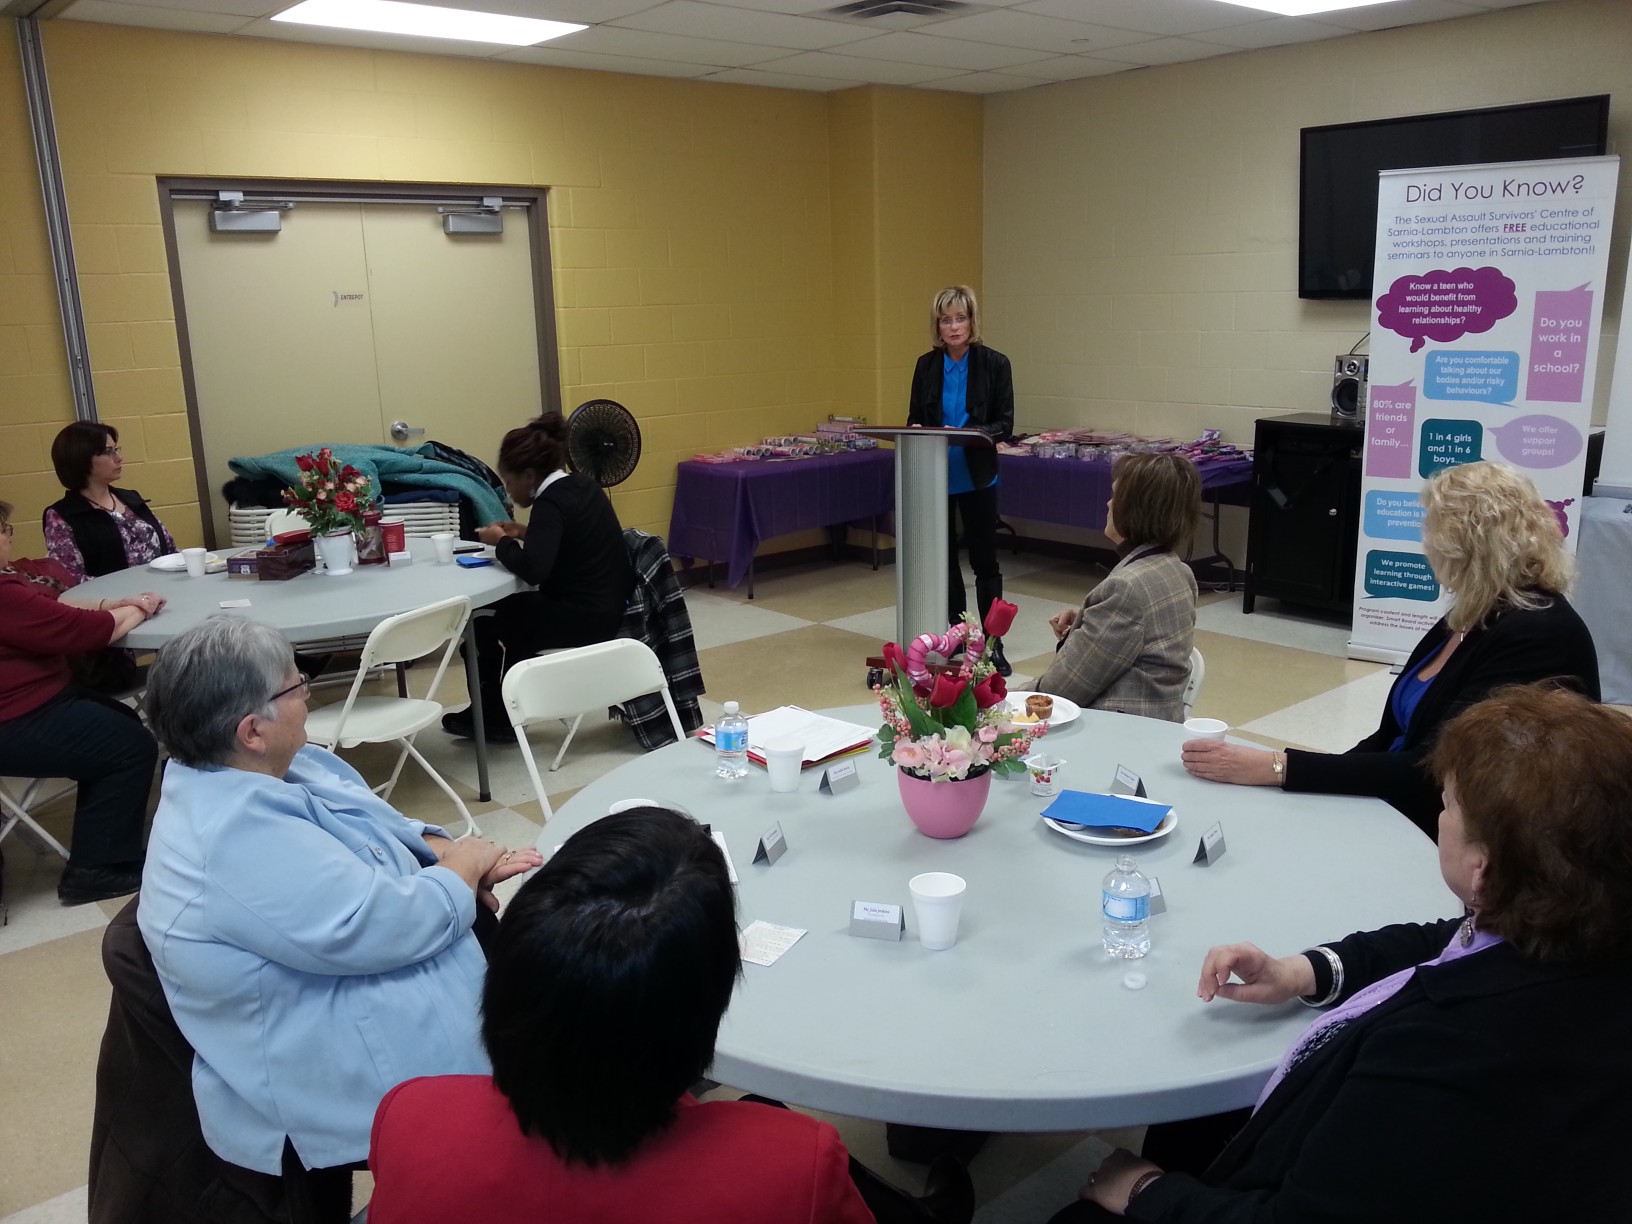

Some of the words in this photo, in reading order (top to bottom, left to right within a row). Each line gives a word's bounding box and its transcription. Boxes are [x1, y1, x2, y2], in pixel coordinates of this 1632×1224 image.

[1406, 183, 1443, 203] Did
[1451, 182, 1494, 200] You
[1502, 174, 1585, 198] Know?
[1394, 216, 1412, 225] The
[1414, 214, 1448, 224] Sexual
[1450, 212, 1486, 222] Assault
[1540, 209, 1579, 219] Centre
[1582, 206, 1595, 217] of
[1387, 225, 1468, 237] Sarnia-Lambton
[1470, 224, 1499, 234] offers
[1503, 223, 1527, 233] FREE
[1530, 220, 1600, 231] educational
[1392, 238, 1447, 248] workshops,
[1450, 236, 1521, 248] presentations
[1523, 234, 1547, 244] and
[1550, 233, 1592, 244] training
[1387, 251, 1430, 260] seminars
[1433, 250, 1443, 259] to
[1446, 249, 1486, 259] anyone
[1489, 248, 1498, 257] in
[1501, 245, 1595, 257] Sarnia-Lambton!!
[1409, 282, 1431, 290] Know
[1440, 282, 1456, 290] teen
[1457, 282, 1474, 290] who
[1406, 293, 1429, 302] would
[1430, 293, 1456, 301] benefit
[1458, 293, 1476, 301] from
[1398, 305, 1429, 314] learning
[1430, 304, 1453, 313] about
[1453, 304, 1482, 314] healthy
[1412, 316, 1466, 325] relationships?
[1540, 317, 1557, 327] Do
[1560, 319, 1583, 329] you
[1538, 332, 1567, 342] work
[1570, 332, 1581, 342] in
[1553, 350, 1562, 358] a
[1435, 355, 1449, 363] Are
[1449, 356, 1464, 365] you
[1464, 355, 1509, 364] comfortable
[1440, 366, 1464, 375] talking
[1466, 366, 1488, 374] about
[1489, 367, 1503, 375] our
[1533, 362, 1580, 373] school?
[1436, 375, 1460, 384] bodies
[1461, 376, 1486, 384] and/or
[1486, 377, 1505, 386] risky
[1446, 386, 1492, 395] behaviours?
[1373, 399, 1393, 409] 80%
[1395, 401, 1412, 409] are
[1375, 412, 1407, 422] friends
[1522, 424, 1537, 433] We
[1538, 425, 1558, 434] offer
[1371, 437, 1409, 448] family...
[1429, 432, 1433, 440] 1
[1435, 432, 1444, 441] in
[1445, 433, 1452, 441] 4
[1453, 433, 1472, 443] girls
[1522, 437, 1556, 445] support
[1427, 444, 1445, 453] and
[1448, 445, 1452, 453] 1
[1454, 445, 1463, 453] in
[1465, 446, 1471, 454] 6
[1376, 497, 1387, 506] Do
[1387, 499, 1402, 507] you
[1376, 508, 1412, 517] education
[1387, 519, 1421, 528] preventio
[1381, 558, 1394, 567] We
[1394, 560, 1426, 570] promote
[1373, 568, 1402, 578] learning
[1403, 571, 1432, 582] through
[1369, 577, 1407, 588] interactive
[1408, 583, 1435, 591] games!
